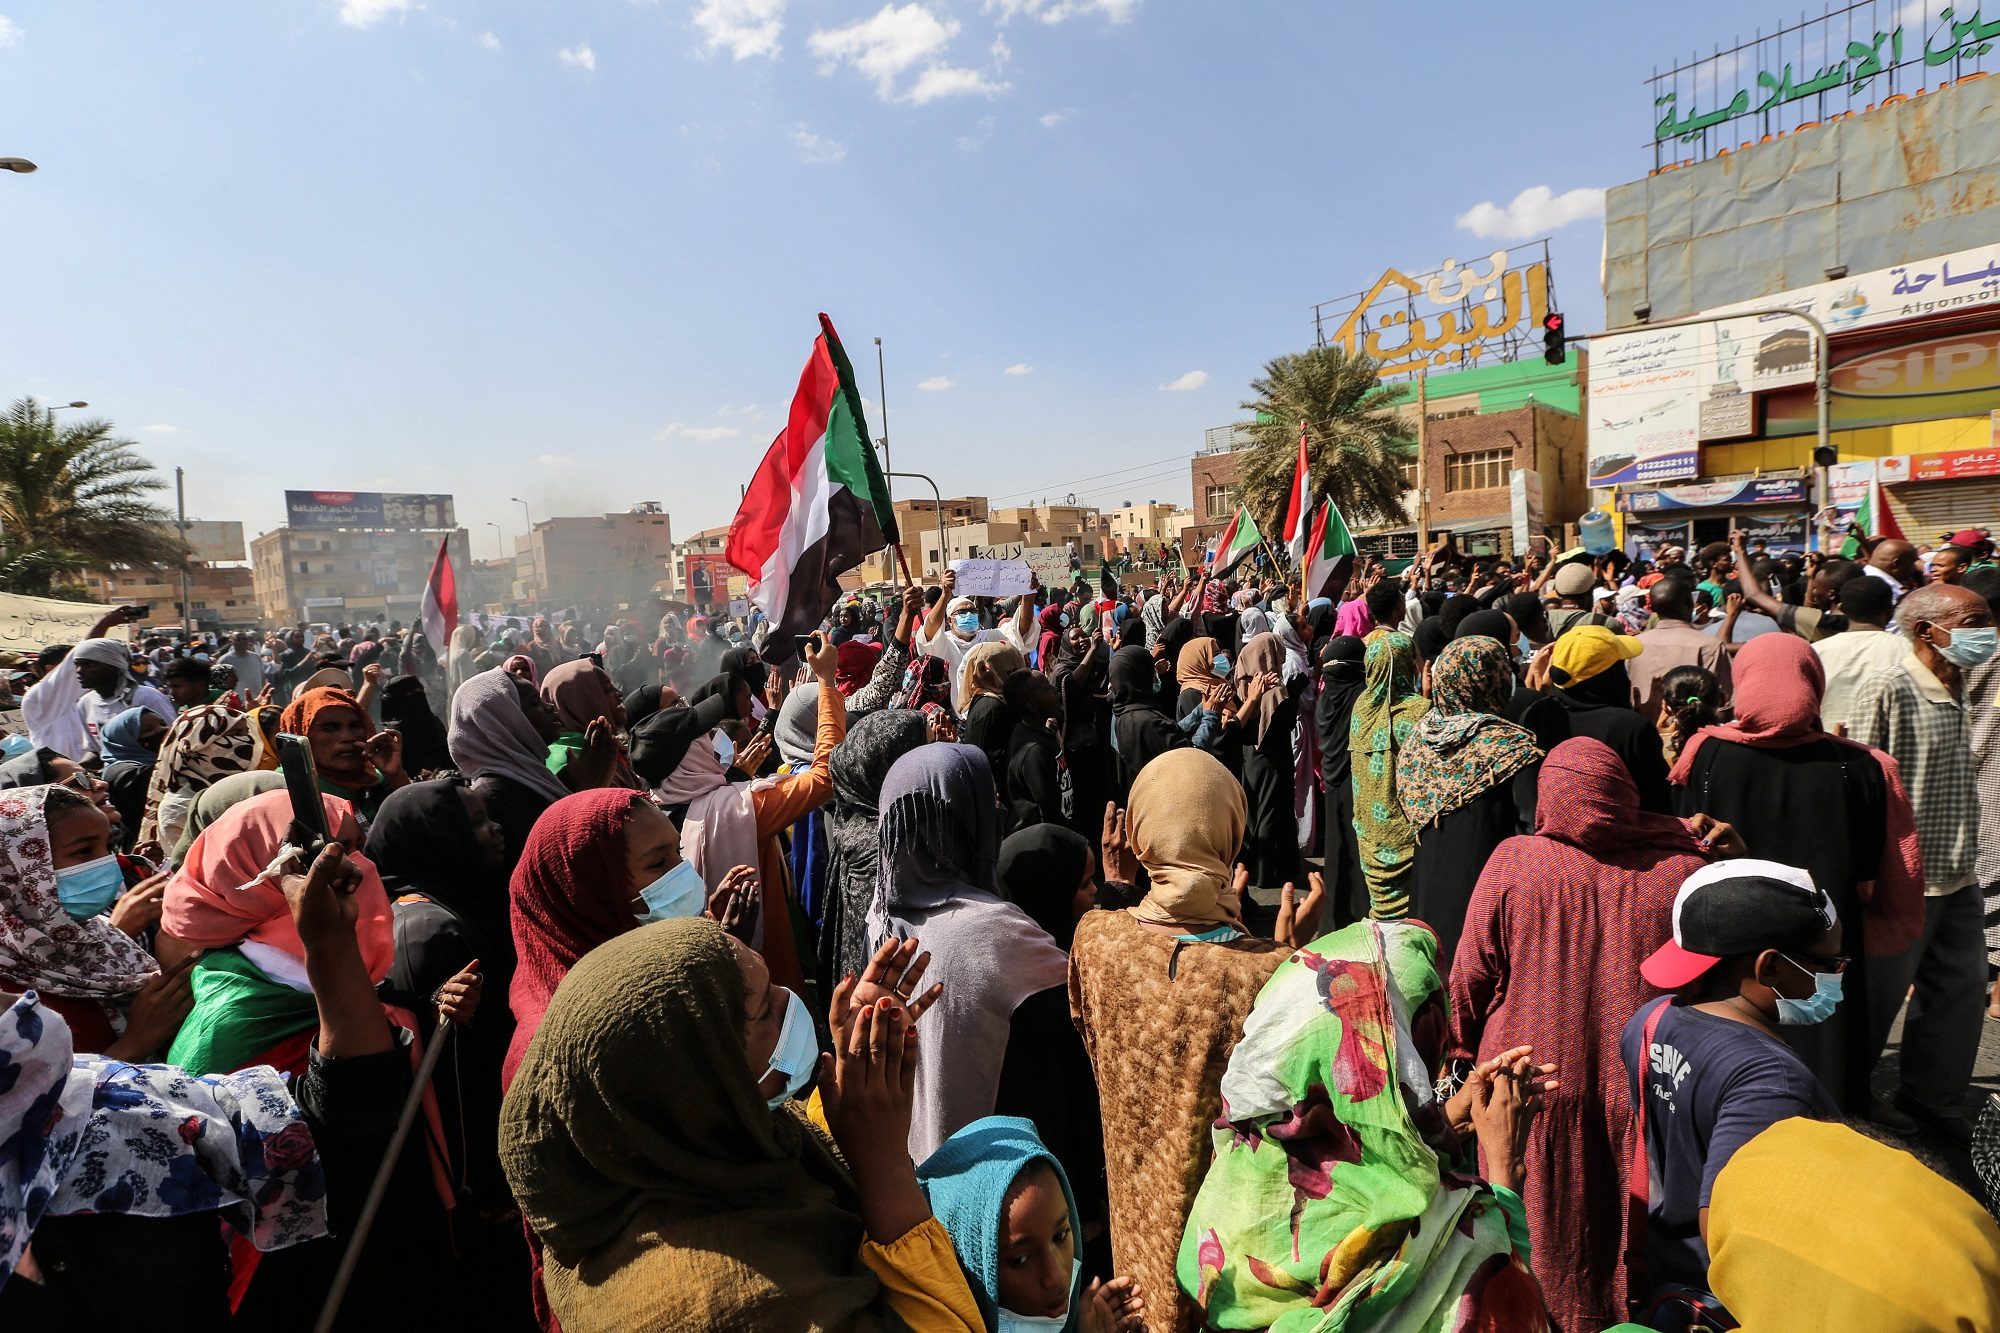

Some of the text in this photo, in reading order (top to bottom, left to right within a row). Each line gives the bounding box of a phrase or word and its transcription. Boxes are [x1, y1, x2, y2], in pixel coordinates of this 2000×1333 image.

[1655, 24, 1903, 144] الإسلامية
[1365, 263, 1551, 366] البيت
[1855, 342, 2000, 389] SIP
